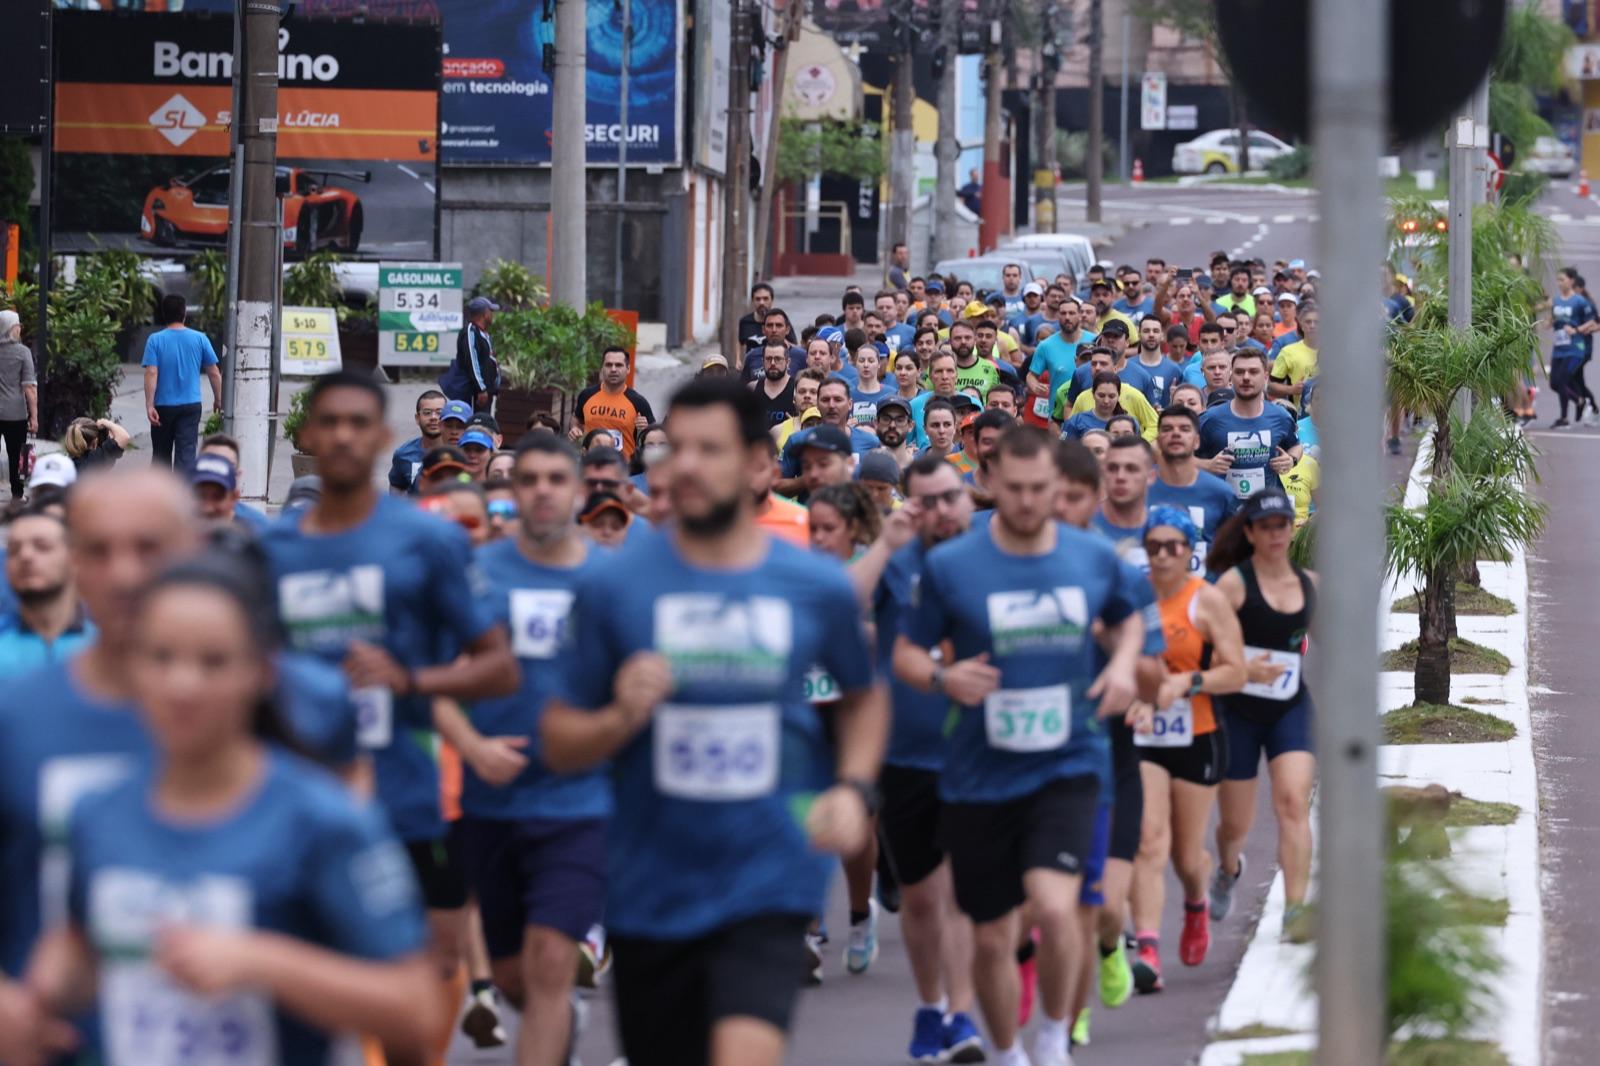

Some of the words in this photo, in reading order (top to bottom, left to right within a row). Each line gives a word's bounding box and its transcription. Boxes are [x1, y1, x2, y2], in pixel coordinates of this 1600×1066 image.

[153, 41, 339, 82] Bamino
[443, 82, 466, 94] em
[469, 80, 549, 96] tecnologia
[163, 110, 195, 129] SL
[583, 124, 660, 143] SECURI
[387, 272, 442, 285] GASOLINA
[443, 273, 455, 285] C.
[396, 292, 439, 308] 5.34
[396, 334, 438, 352] 5.49
[1239, 480, 1251, 493] 9
[995, 708, 1063, 738] 376
[1152, 715, 1186, 736] 04
